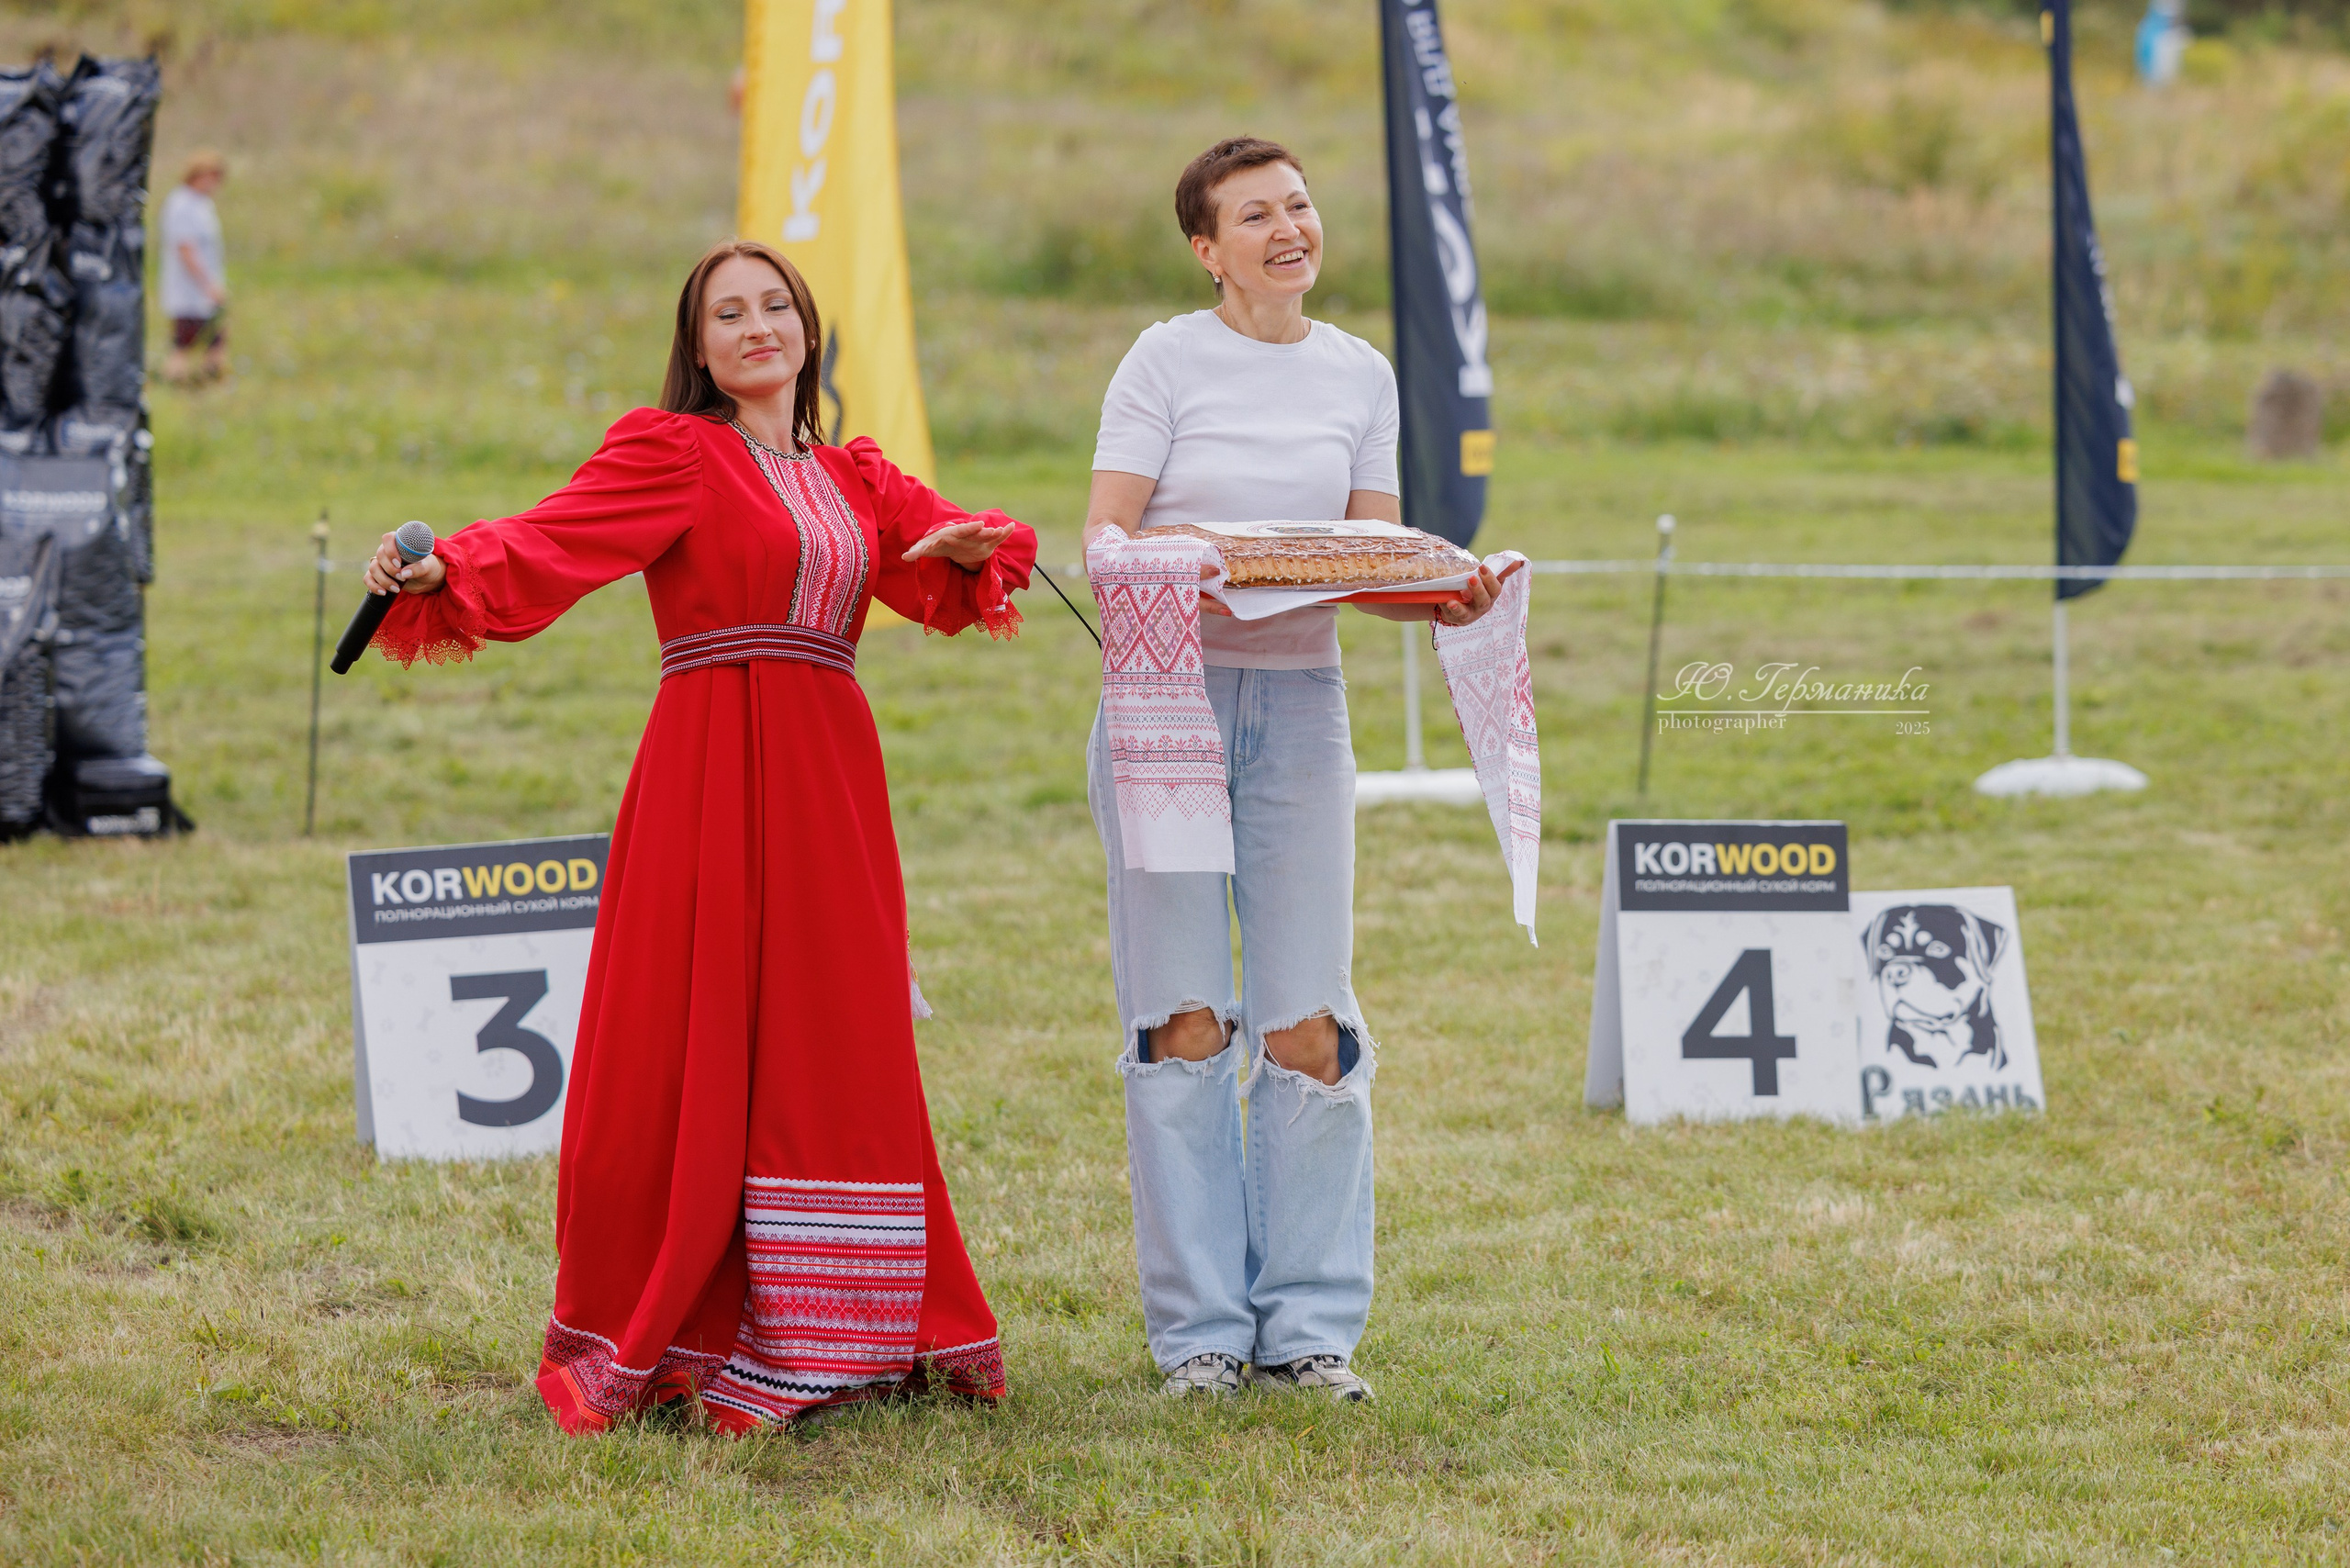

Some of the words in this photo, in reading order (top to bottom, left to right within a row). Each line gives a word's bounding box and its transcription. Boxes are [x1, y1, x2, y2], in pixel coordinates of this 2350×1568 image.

[371, 857, 599, 906] KORWOOD
[1634, 842, 1837, 876] KORWOOD
[374, 900, 511, 924] ПОЛНОРАЦИОННЫЙ
[512, 896, 558, 915] СУХОЙ
[1682, 948, 1797, 1096] 4
[450, 969, 564, 1127] 3
